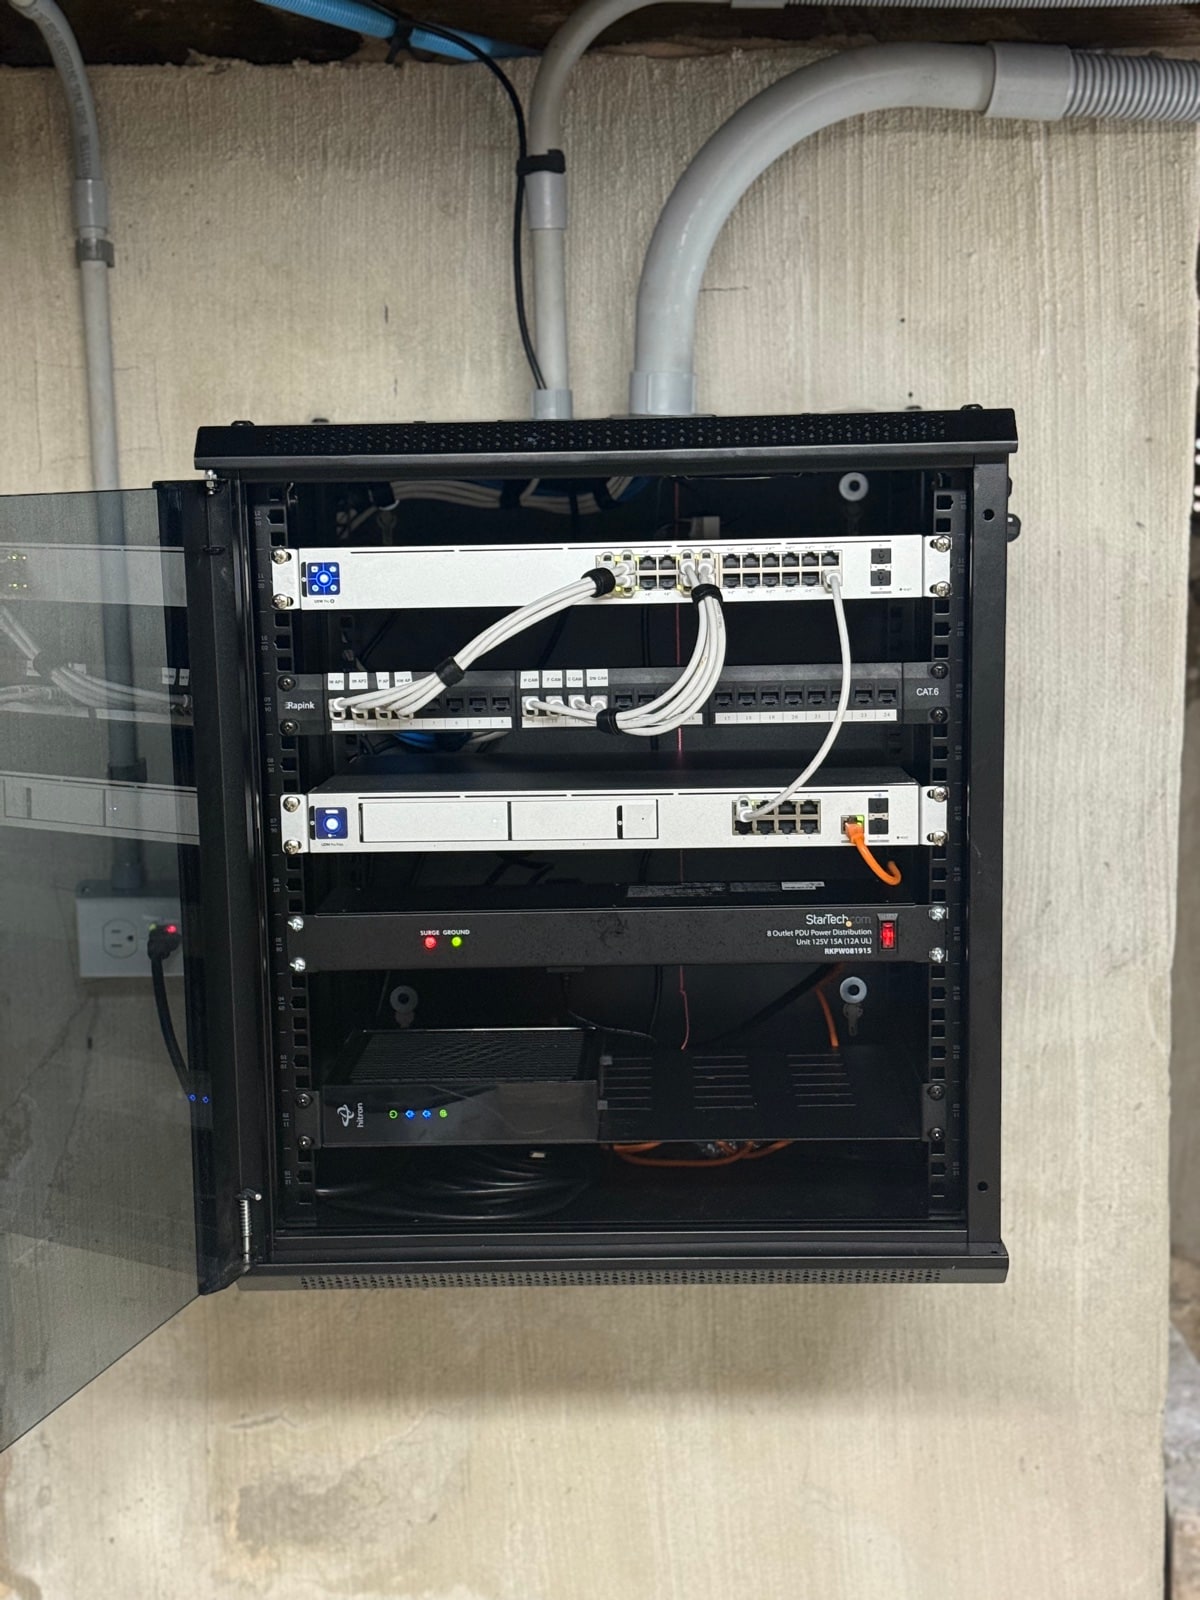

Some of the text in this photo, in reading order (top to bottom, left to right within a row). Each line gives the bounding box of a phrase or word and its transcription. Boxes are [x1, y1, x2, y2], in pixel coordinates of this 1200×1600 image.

[916, 687, 940, 697] CAT.6
[286, 701, 315, 711] Rapink
[772, 929, 794, 937] Outlet
[795, 929, 810, 937] PDU
[832, 928, 872, 936] Distribution
[796, 937, 872, 946] Unit 125V 15A (12A UL)
[356, 1102, 364, 1128] hitron
